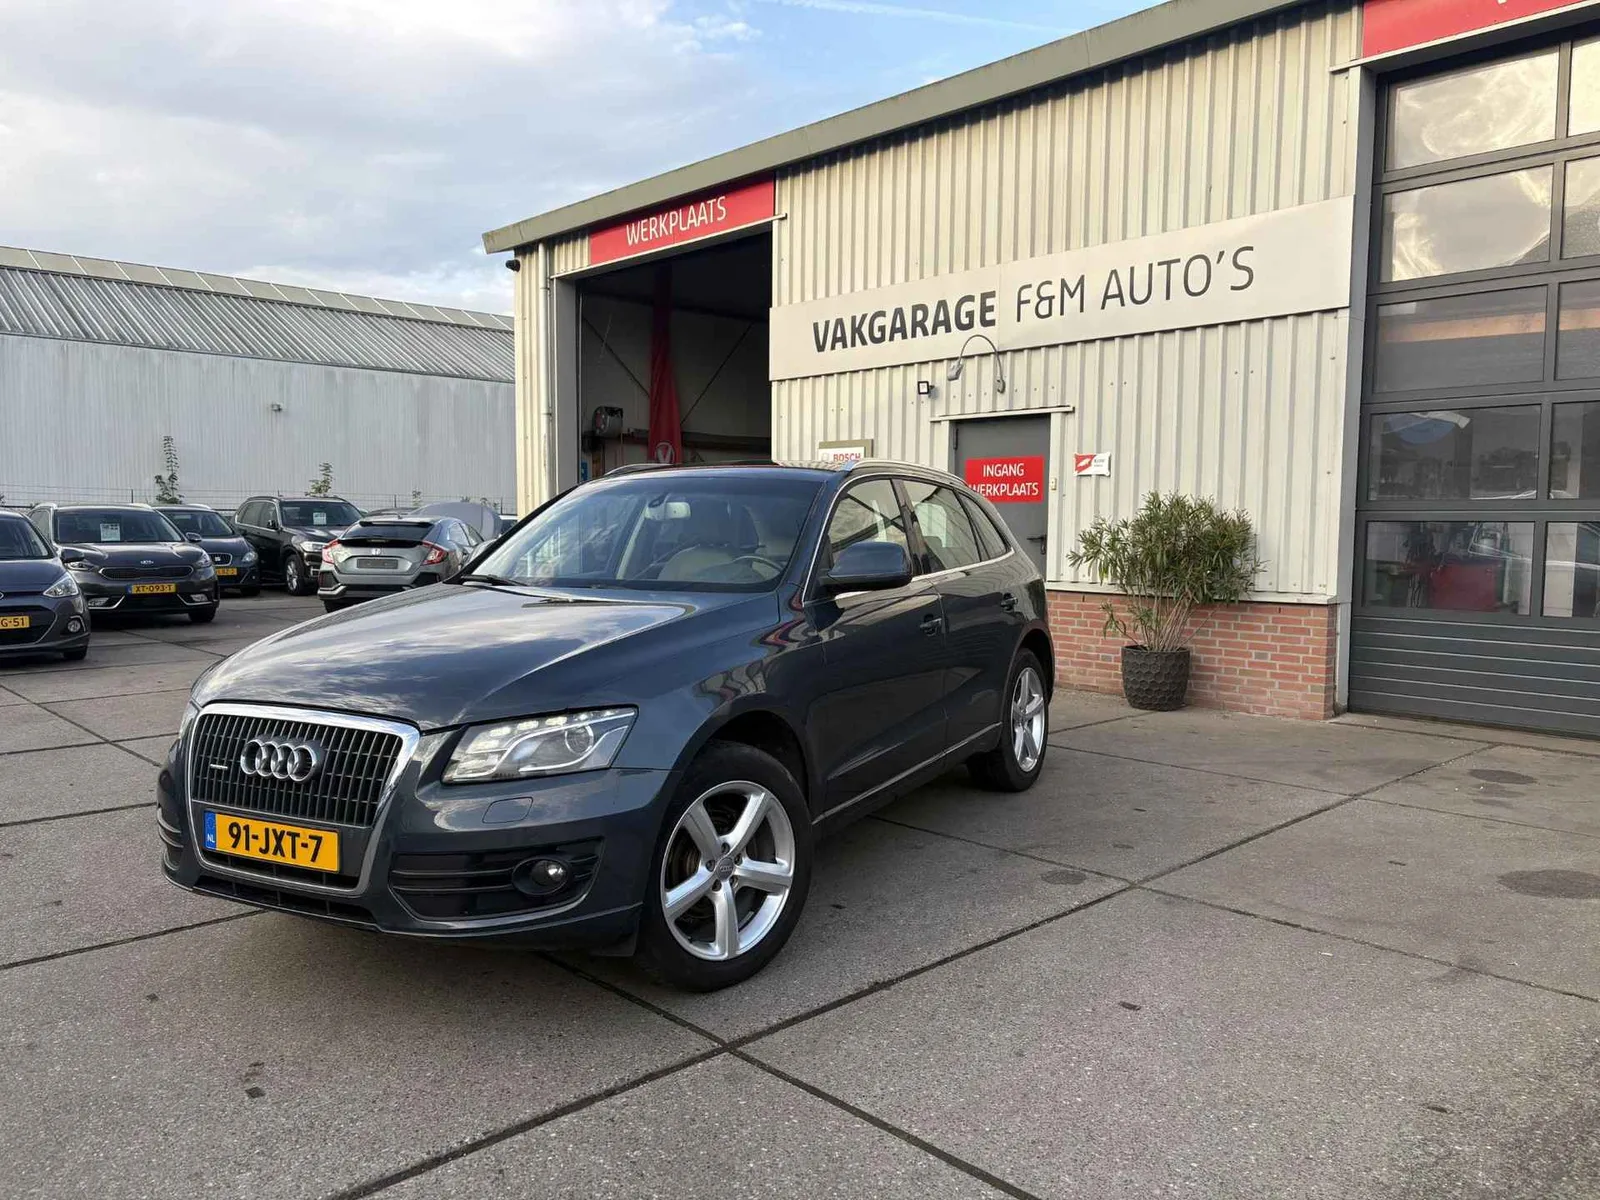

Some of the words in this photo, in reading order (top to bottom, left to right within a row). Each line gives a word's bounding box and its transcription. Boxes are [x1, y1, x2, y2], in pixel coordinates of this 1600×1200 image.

[626, 196, 727, 246] WERKPLAATS
[812, 290, 997, 353] VAKGARAGE
[1015, 273, 1085, 322] F&M
[1100, 245, 1255, 311] AUTO'S
[833, 453, 861, 462] BOSCH
[983, 463, 1025, 477] INGANG
[135, 584, 173, 592] XT-093-T
[206, 833, 216, 843] NL
[228, 821, 323, 863] 91-JXT-7
